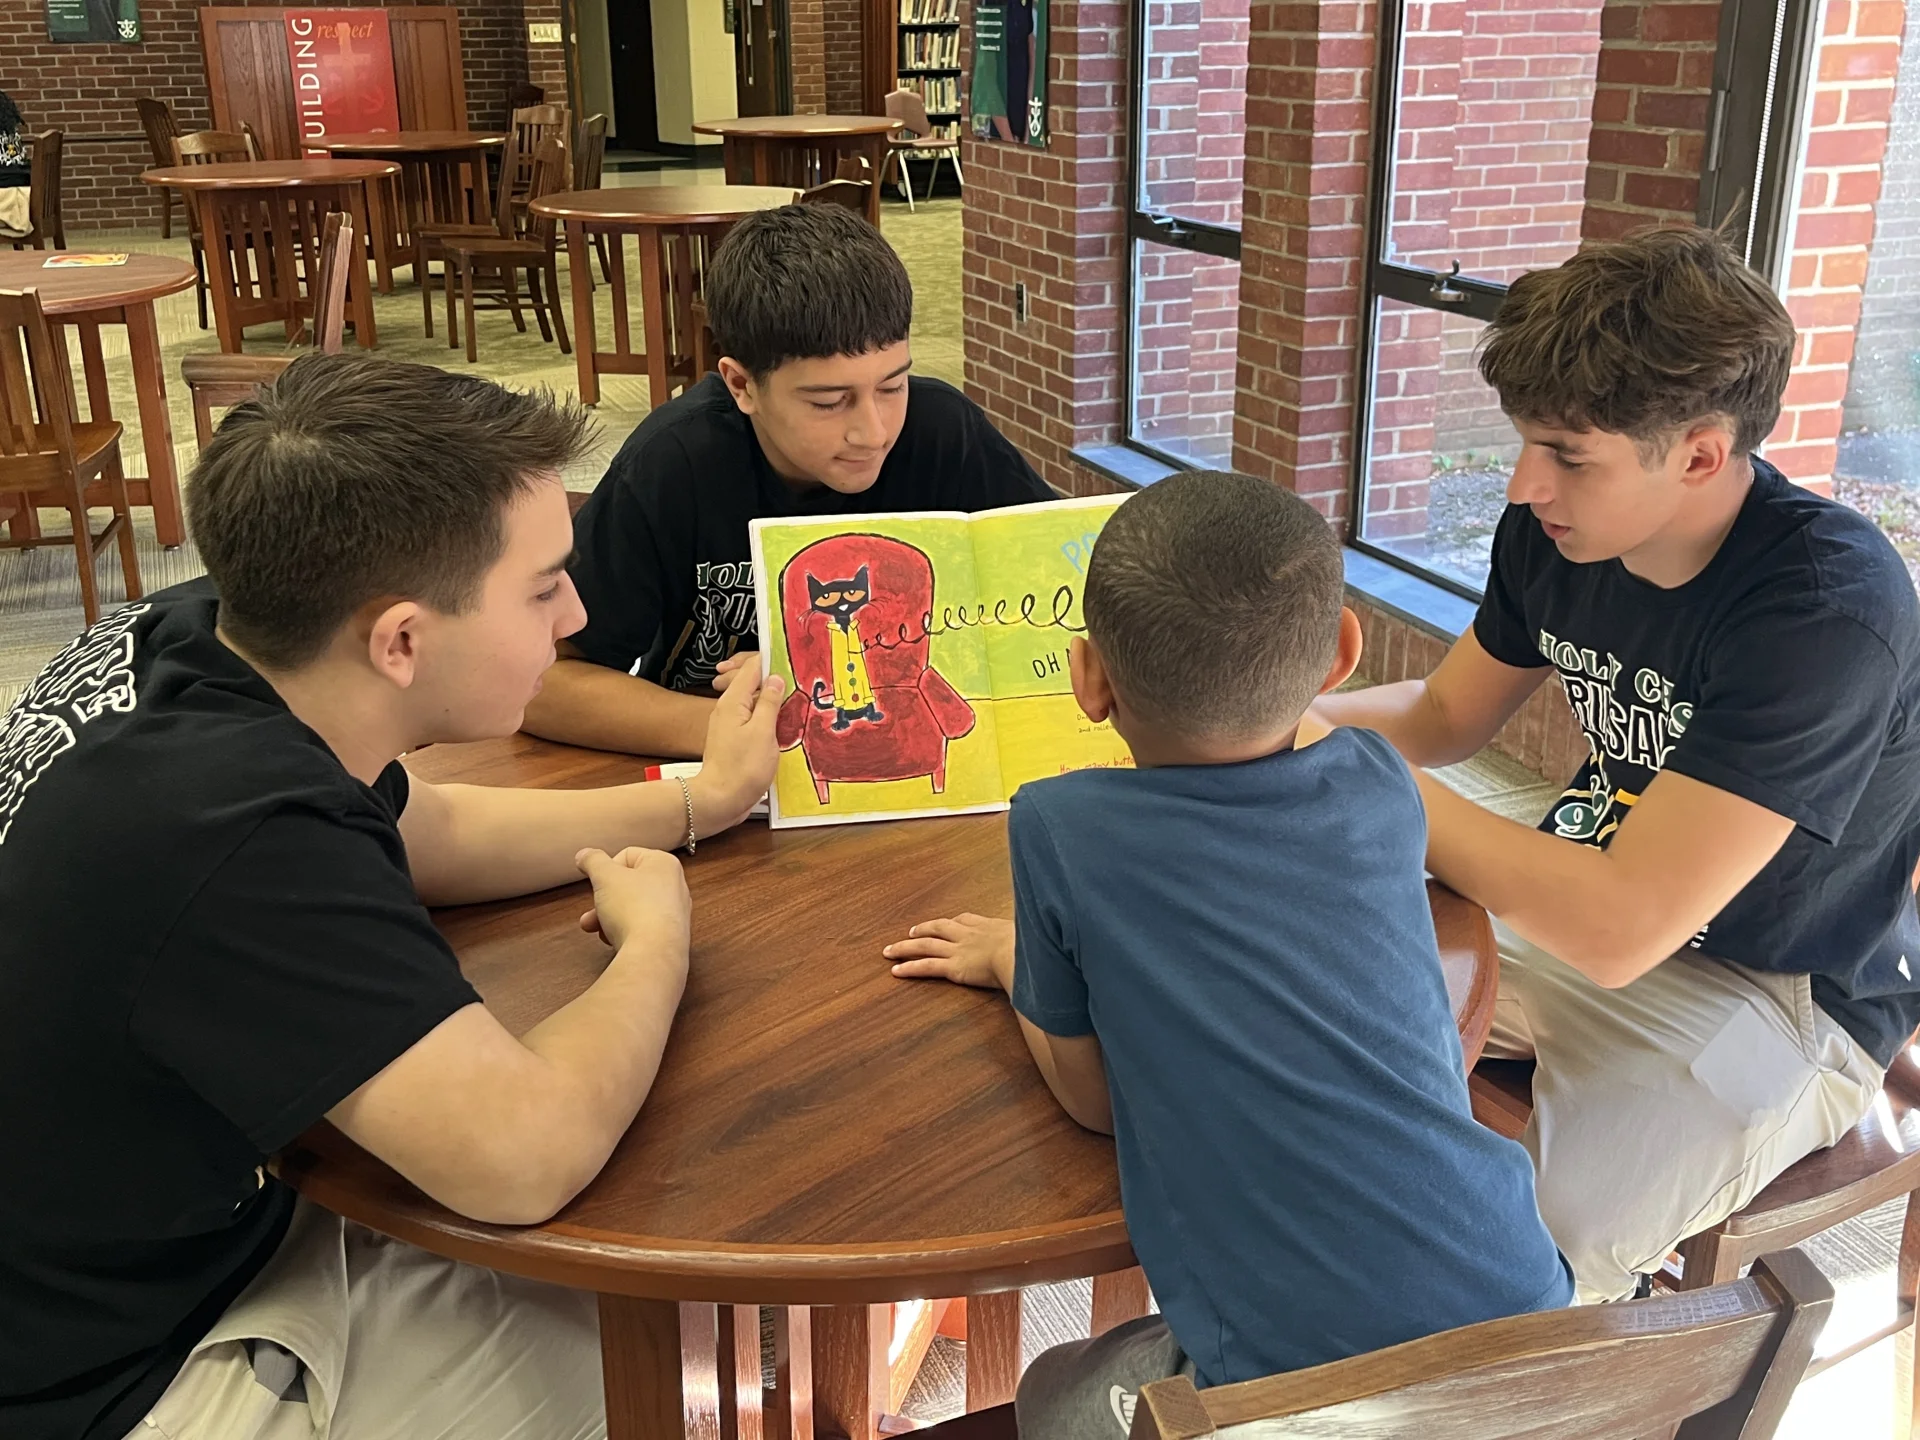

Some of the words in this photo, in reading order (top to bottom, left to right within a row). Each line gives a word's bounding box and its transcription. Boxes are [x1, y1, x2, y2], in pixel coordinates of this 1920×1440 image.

[317, 21, 374, 39] resect
[291, 18, 328, 155] UILDING
[1032, 651, 1061, 679] OH
[1078, 725, 1091, 734] and
[1113, 756, 1136, 767] butto
